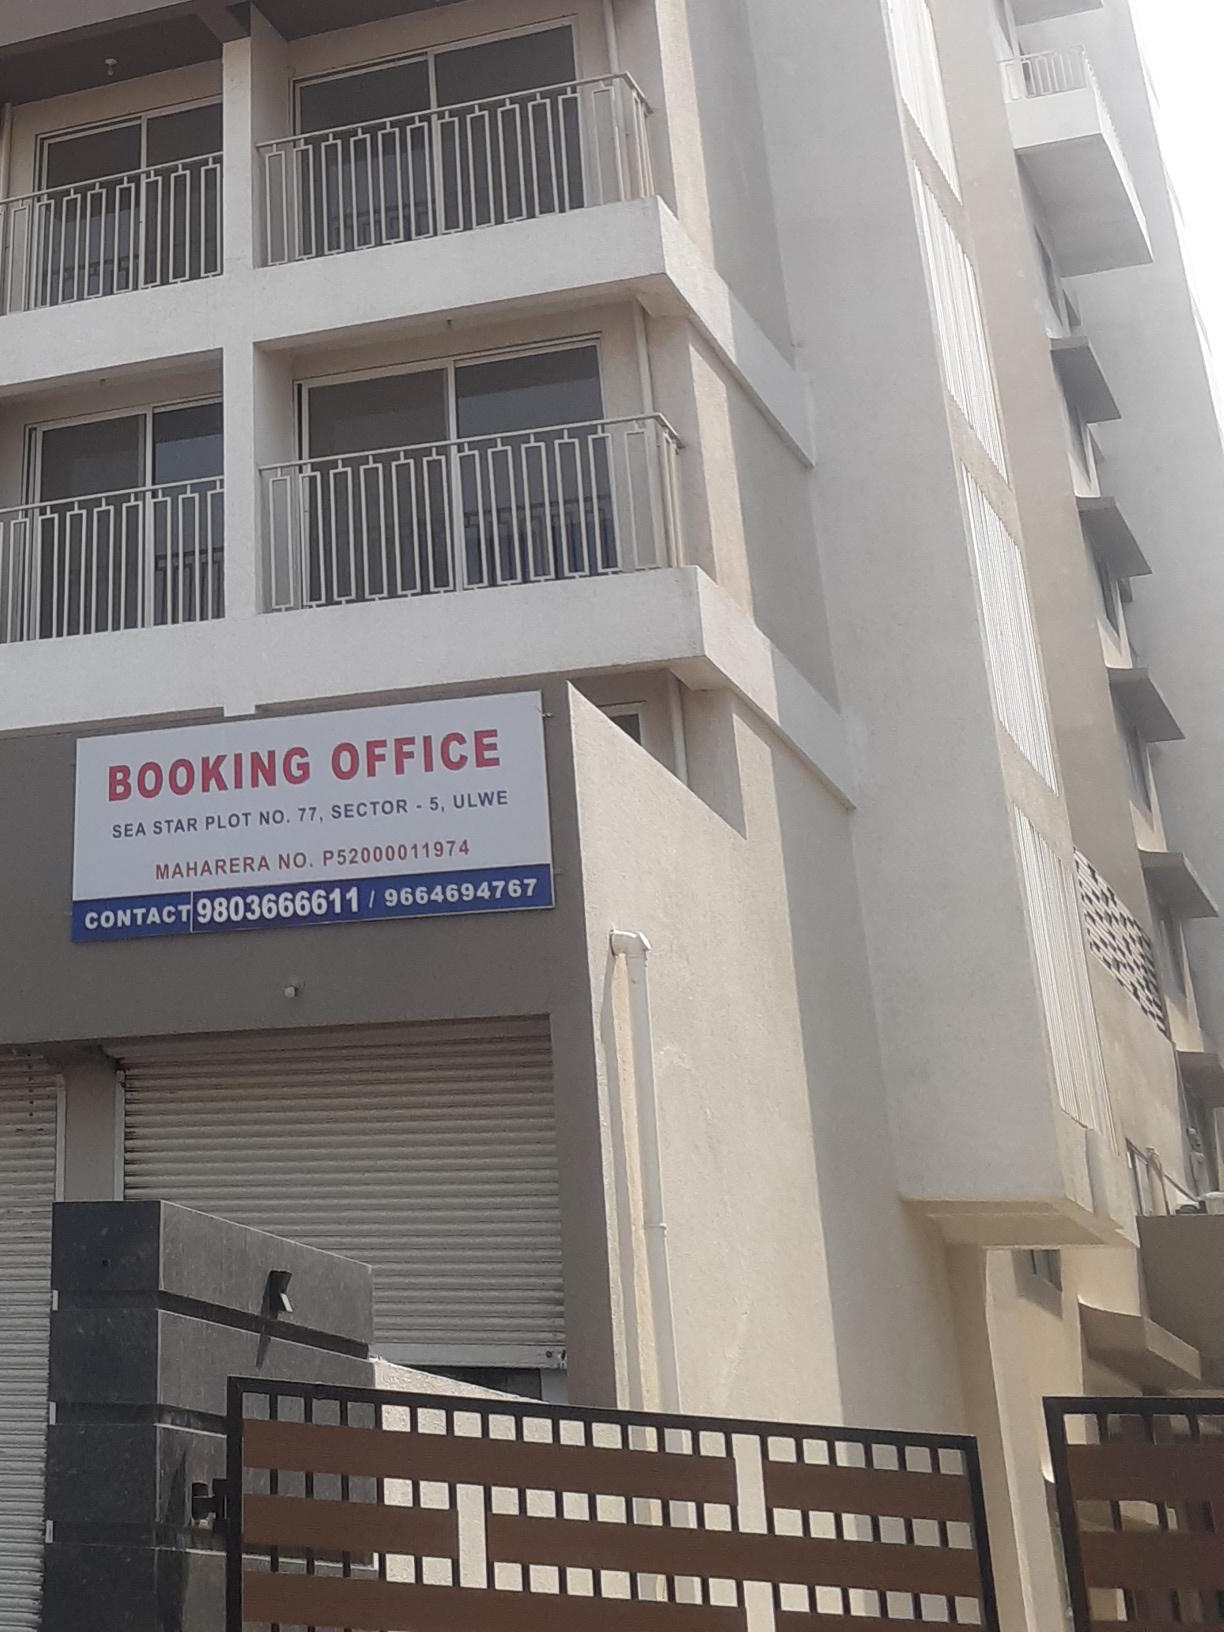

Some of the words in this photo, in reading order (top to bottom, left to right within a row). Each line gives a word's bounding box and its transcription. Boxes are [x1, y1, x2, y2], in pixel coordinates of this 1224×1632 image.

[108, 746, 311, 802] BOOKING
[331, 728, 501, 781] OFFICE
[112, 822, 147, 839] SEA
[153, 817, 199, 836] STAR
[205, 812, 252, 831] PLOT
[259, 809, 291, 826] NO.
[298, 806, 324, 822] 77,
[331, 798, 409, 819] SECTOR
[429, 796, 445, 813] 5,
[453, 789, 509, 809] ULWE
[155, 854, 271, 880] MAHARERA
[278, 851, 313, 870] NO.
[322, 839, 470, 867] P52000011974
[84, 904, 191, 930] CONTACT
[196, 886, 359, 924] 9803666611
[368, 889, 375, 909] /
[384, 878, 538, 907] 9664694767
